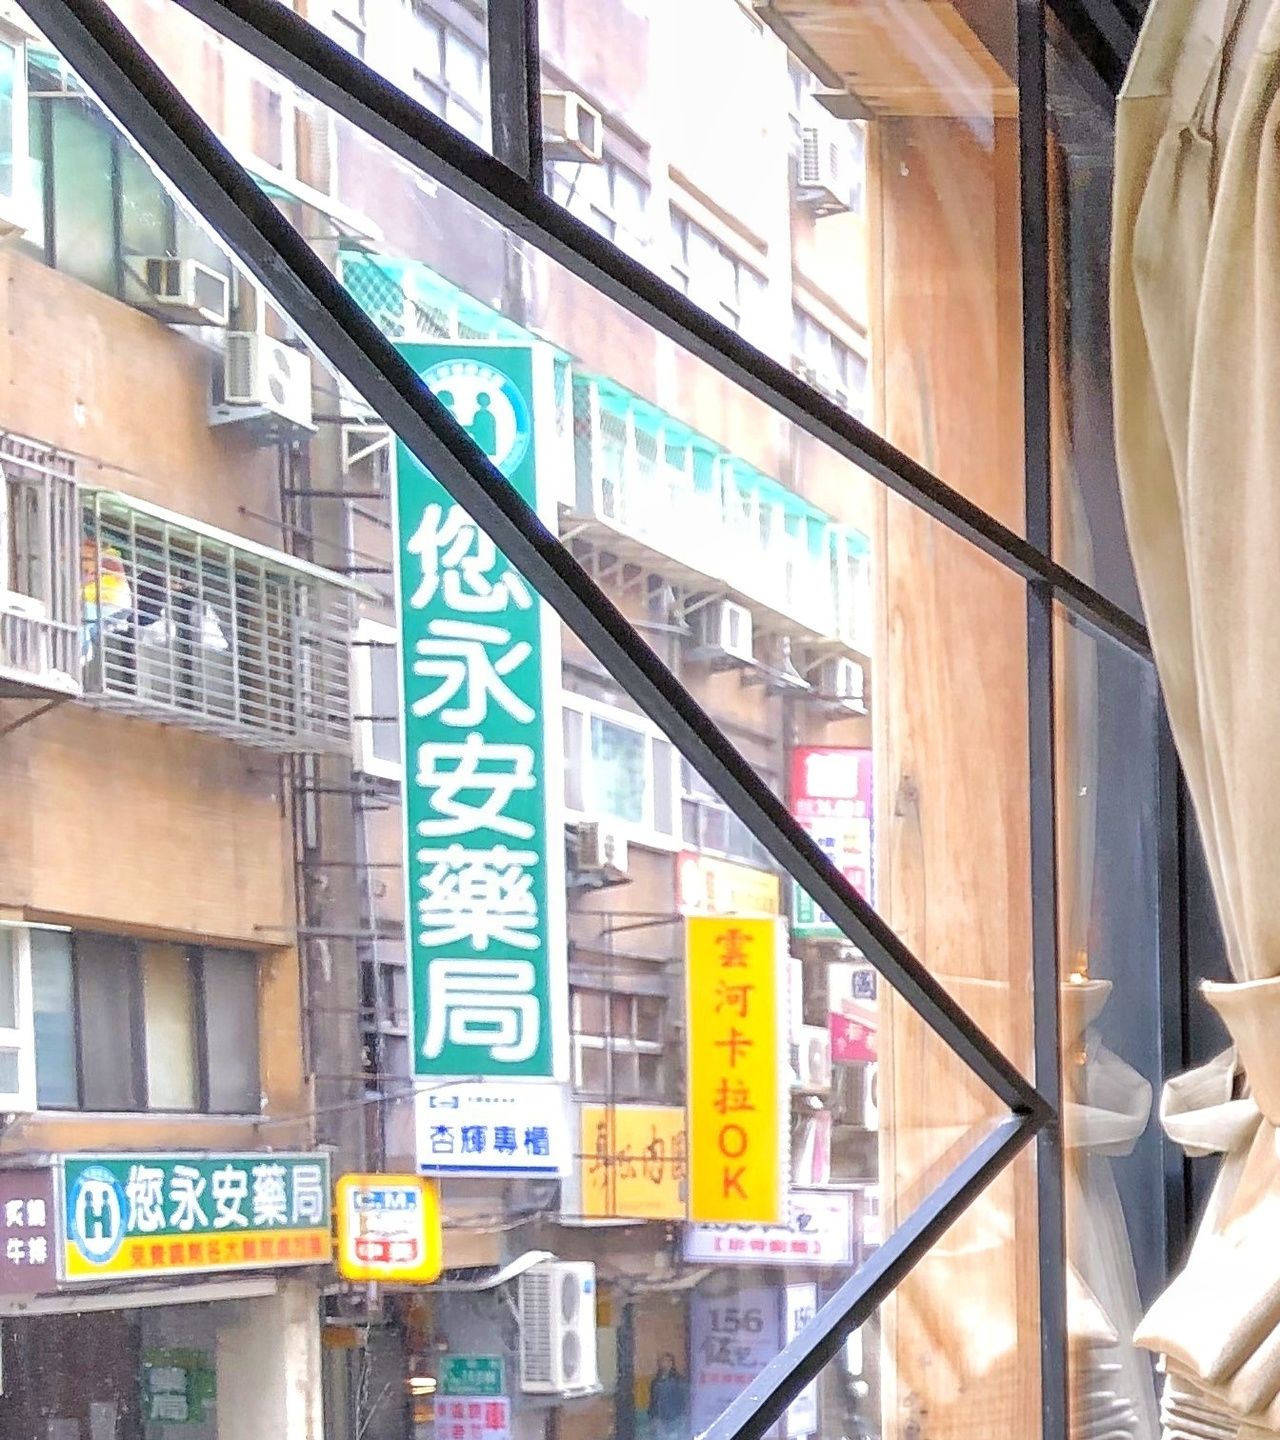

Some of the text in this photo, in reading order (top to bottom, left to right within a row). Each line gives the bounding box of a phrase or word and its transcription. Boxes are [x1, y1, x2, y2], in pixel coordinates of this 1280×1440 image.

[407, 502, 542, 1063] 您永安藥局
[714, 928, 757, 1200] 雲河卡拉OK
[126, 1164, 324, 1233] 您永安藥局
[708, 1307, 764, 1333] 156
